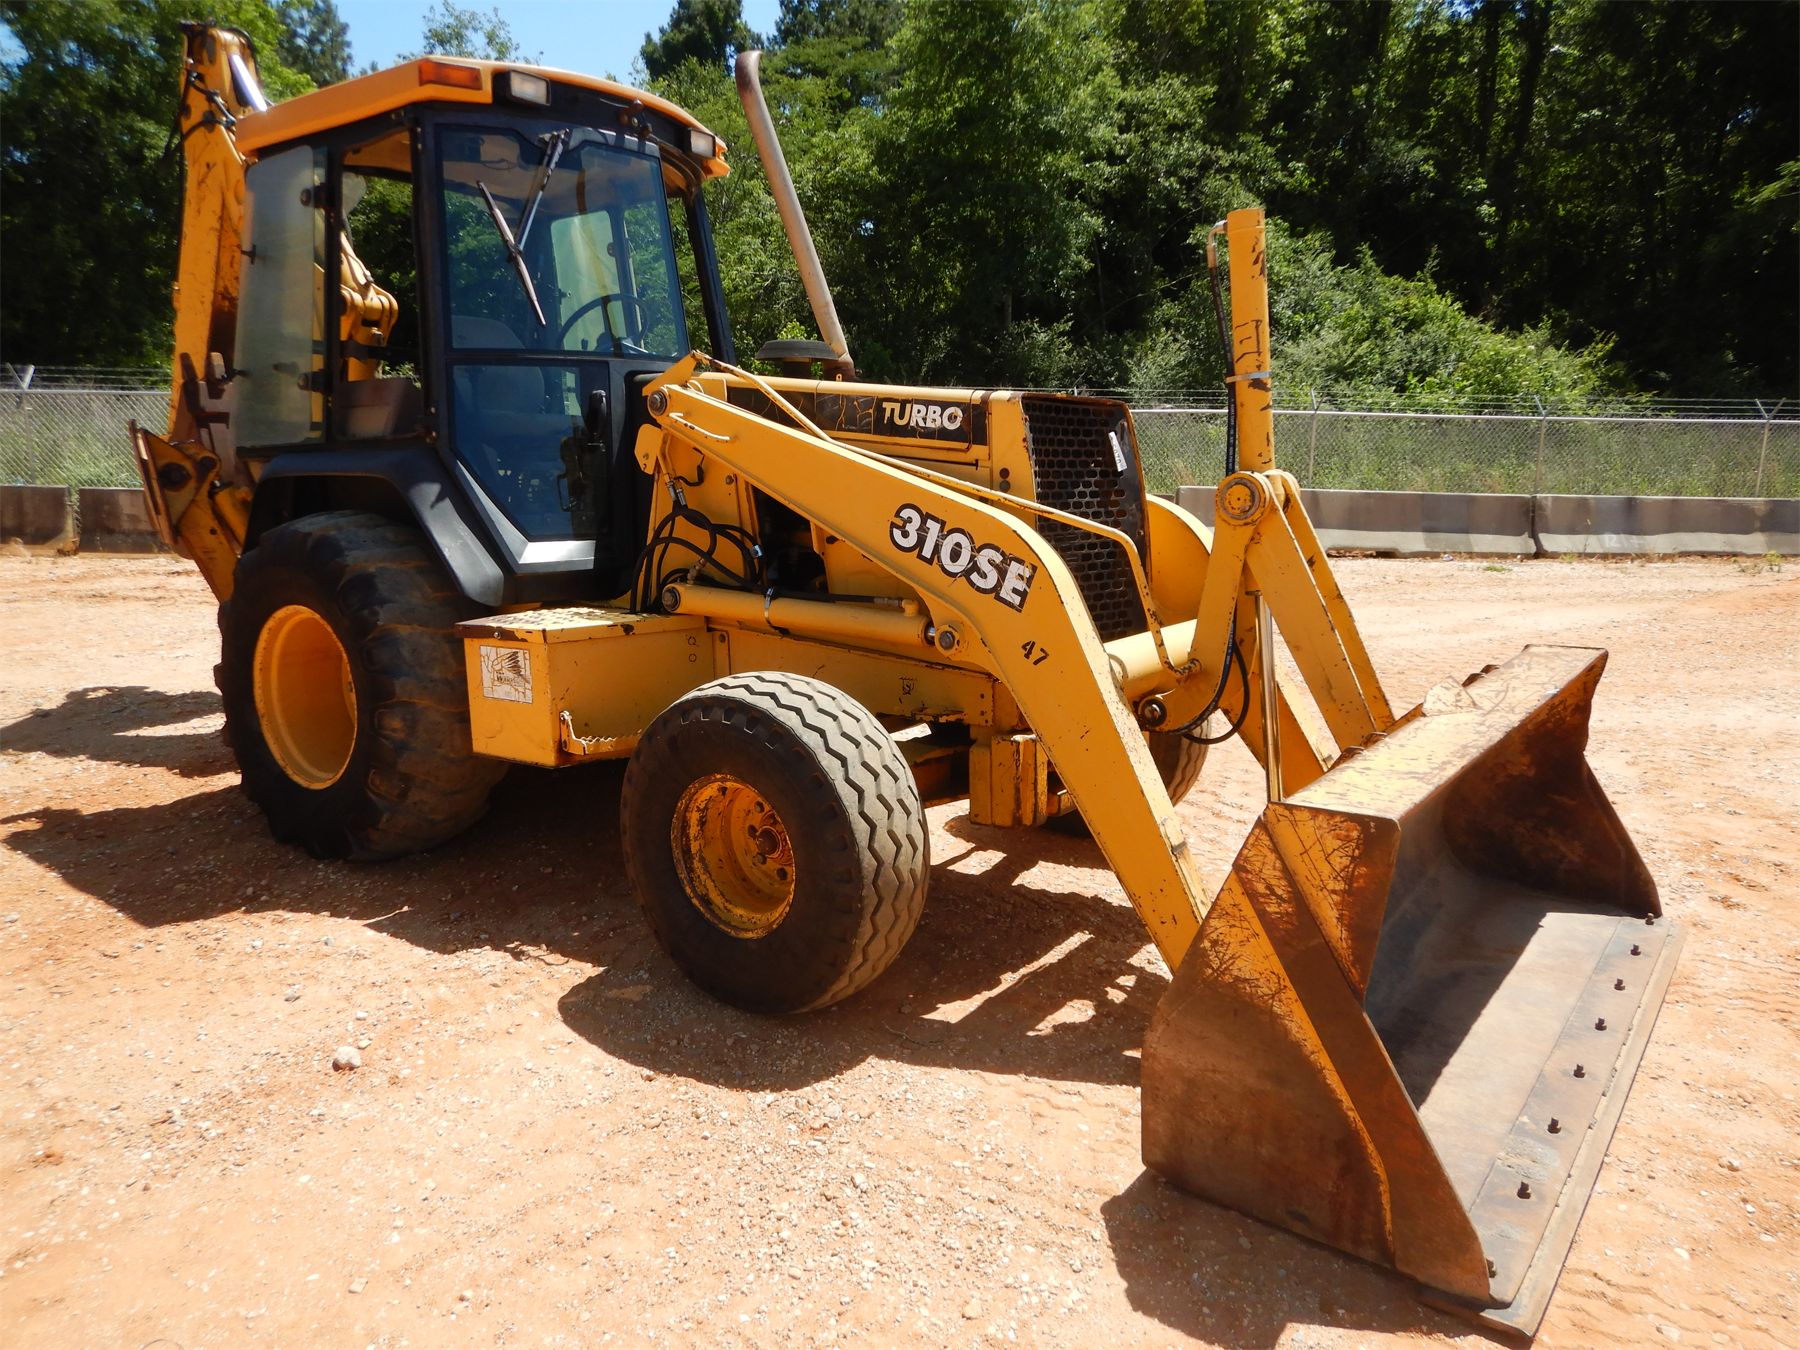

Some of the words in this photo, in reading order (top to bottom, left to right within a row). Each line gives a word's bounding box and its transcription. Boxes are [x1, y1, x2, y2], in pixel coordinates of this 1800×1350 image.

[882, 402, 964, 430] TURBO
[890, 504, 1036, 612] 310SE
[1021, 640, 1050, 666] 47
